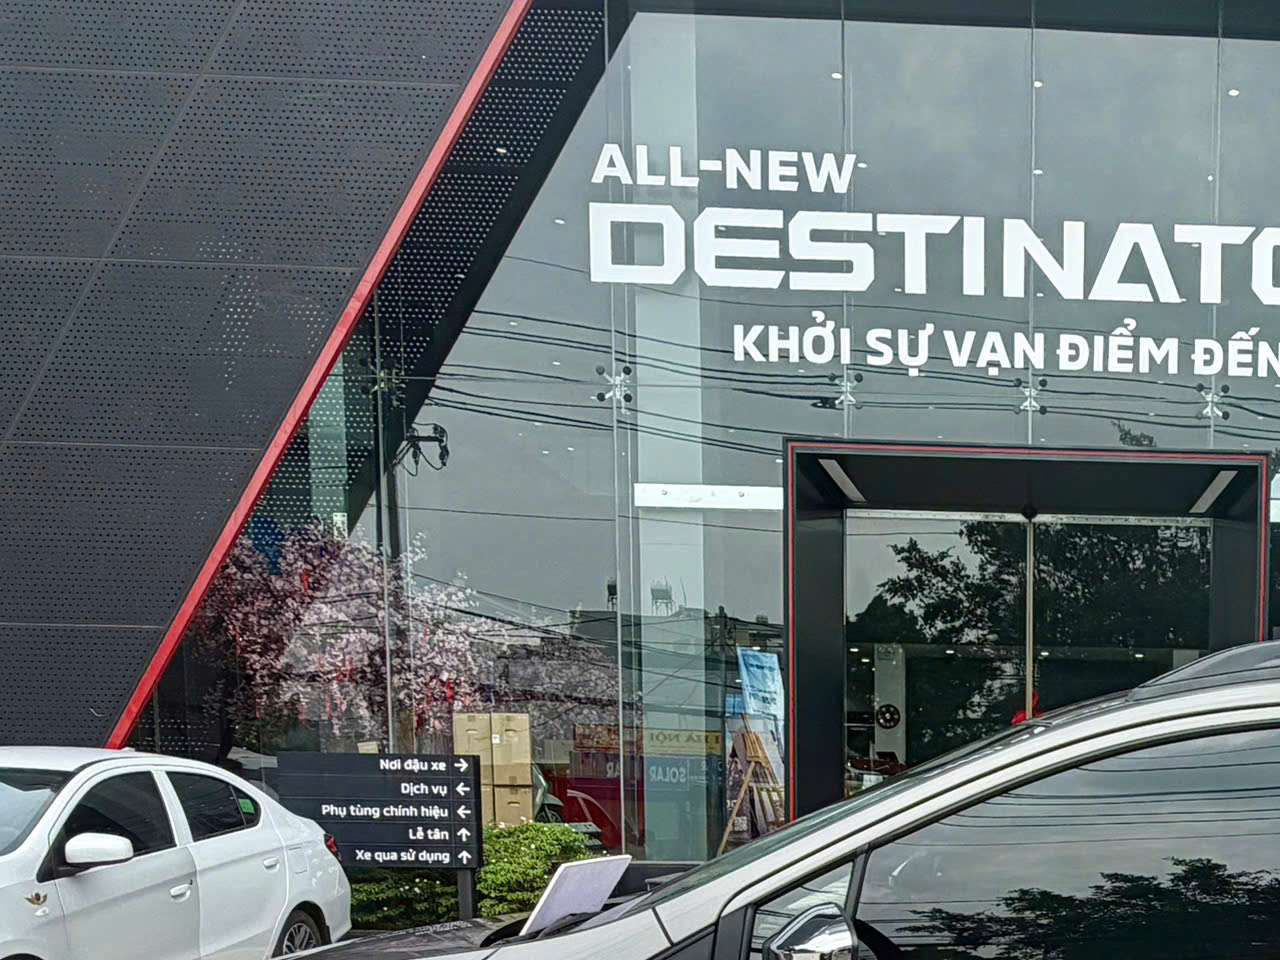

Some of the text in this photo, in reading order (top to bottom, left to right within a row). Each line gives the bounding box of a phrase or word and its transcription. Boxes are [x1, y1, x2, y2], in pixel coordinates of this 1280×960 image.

[590, 143, 857, 194] ALL-NEW
[733, 310, 851, 365] KHỞI
[865, 322, 935, 377] SỰ
[942, 329, 1045, 376] VẠN
[1055, 317, 1179, 375] ĐIỂM
[379, 758, 447, 773] Nơi đậu xe
[400, 782, 448, 797] Dịch vụ
[321, 804, 449, 820] Phụ tùng chính hiệu
[408, 826, 450, 840] Lễ tân
[355, 848, 450, 864] Xe qua sử dụng
